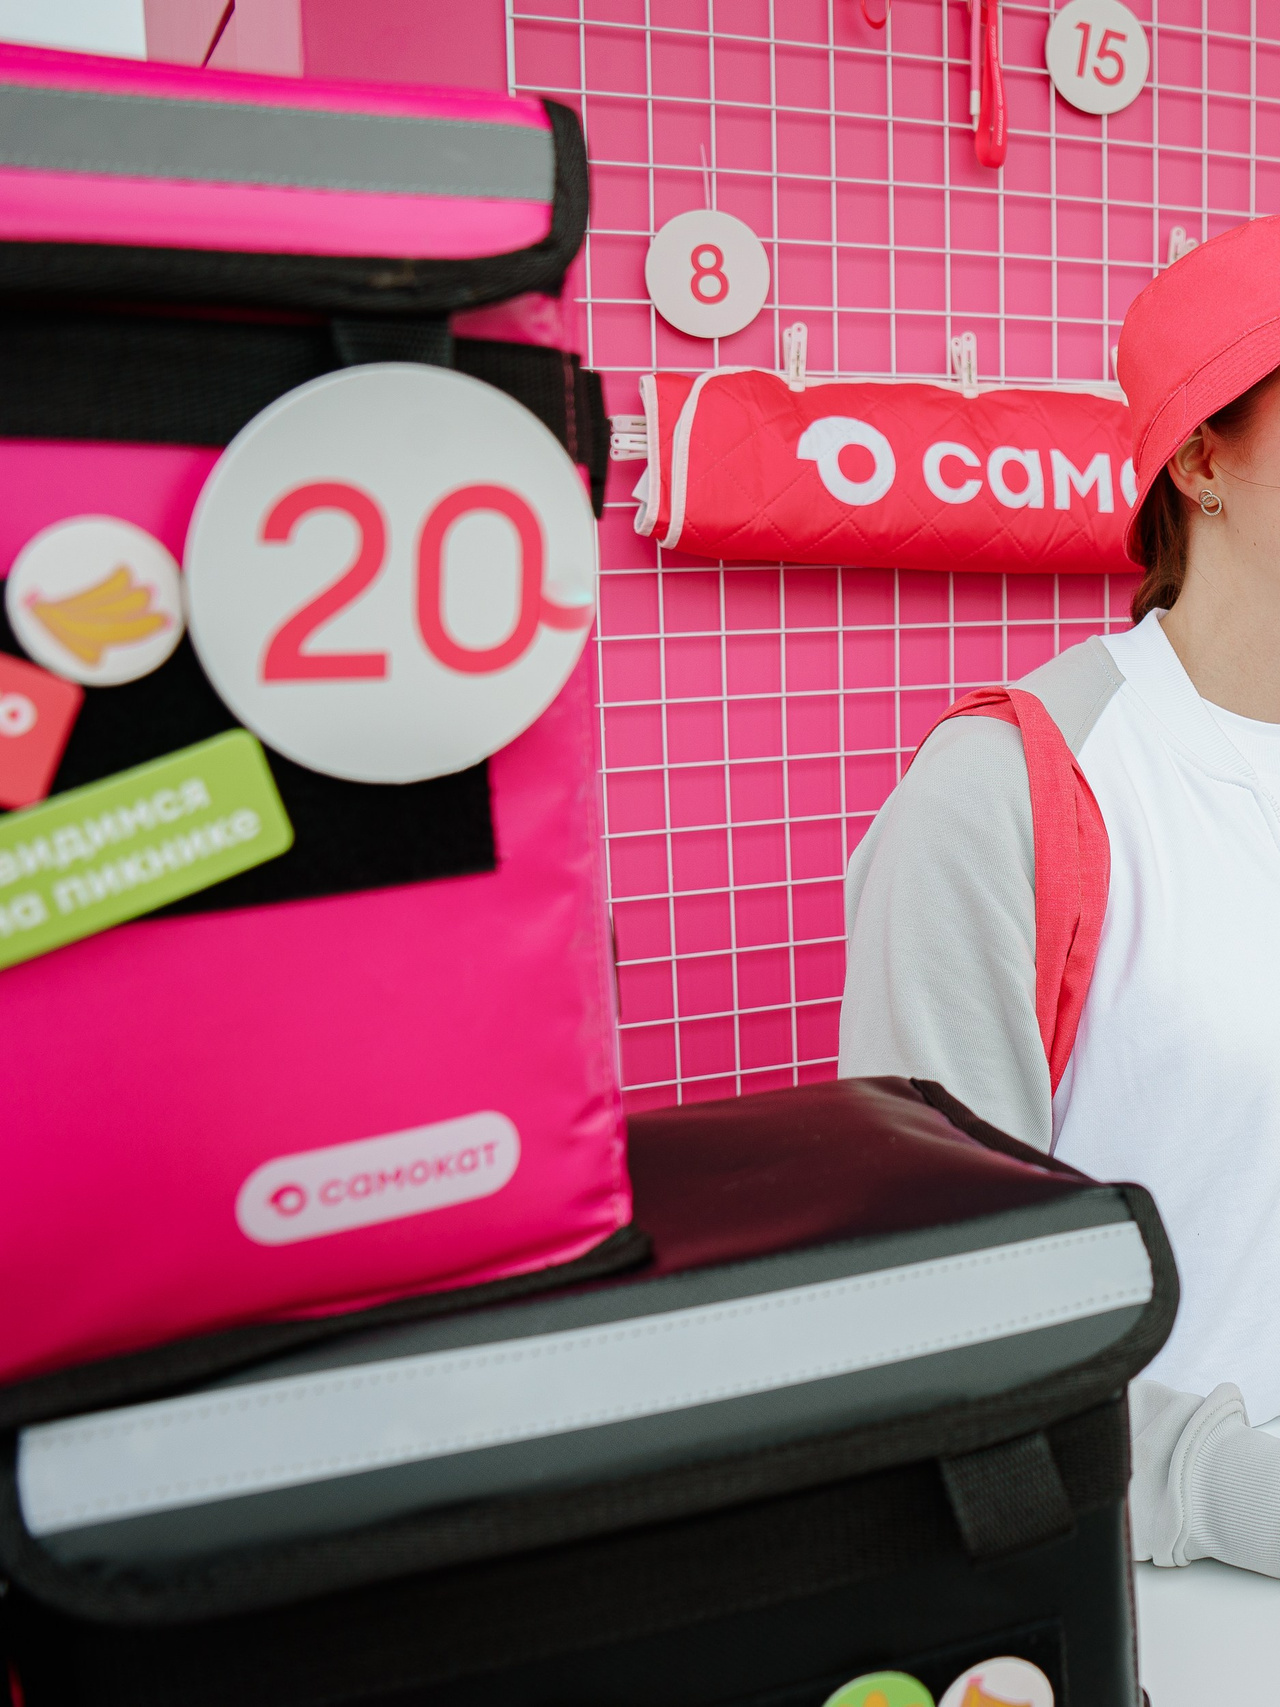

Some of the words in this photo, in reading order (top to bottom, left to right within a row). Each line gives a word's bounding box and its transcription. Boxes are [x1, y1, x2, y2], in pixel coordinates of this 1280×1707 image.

[1075, 21, 1127, 87] 15
[690, 243, 729, 305] 8
[922, 440, 1139, 513] сам
[258, 479, 546, 684] 20
[53, 808, 262, 916] пикнике
[317, 1141, 498, 1206] самокат
